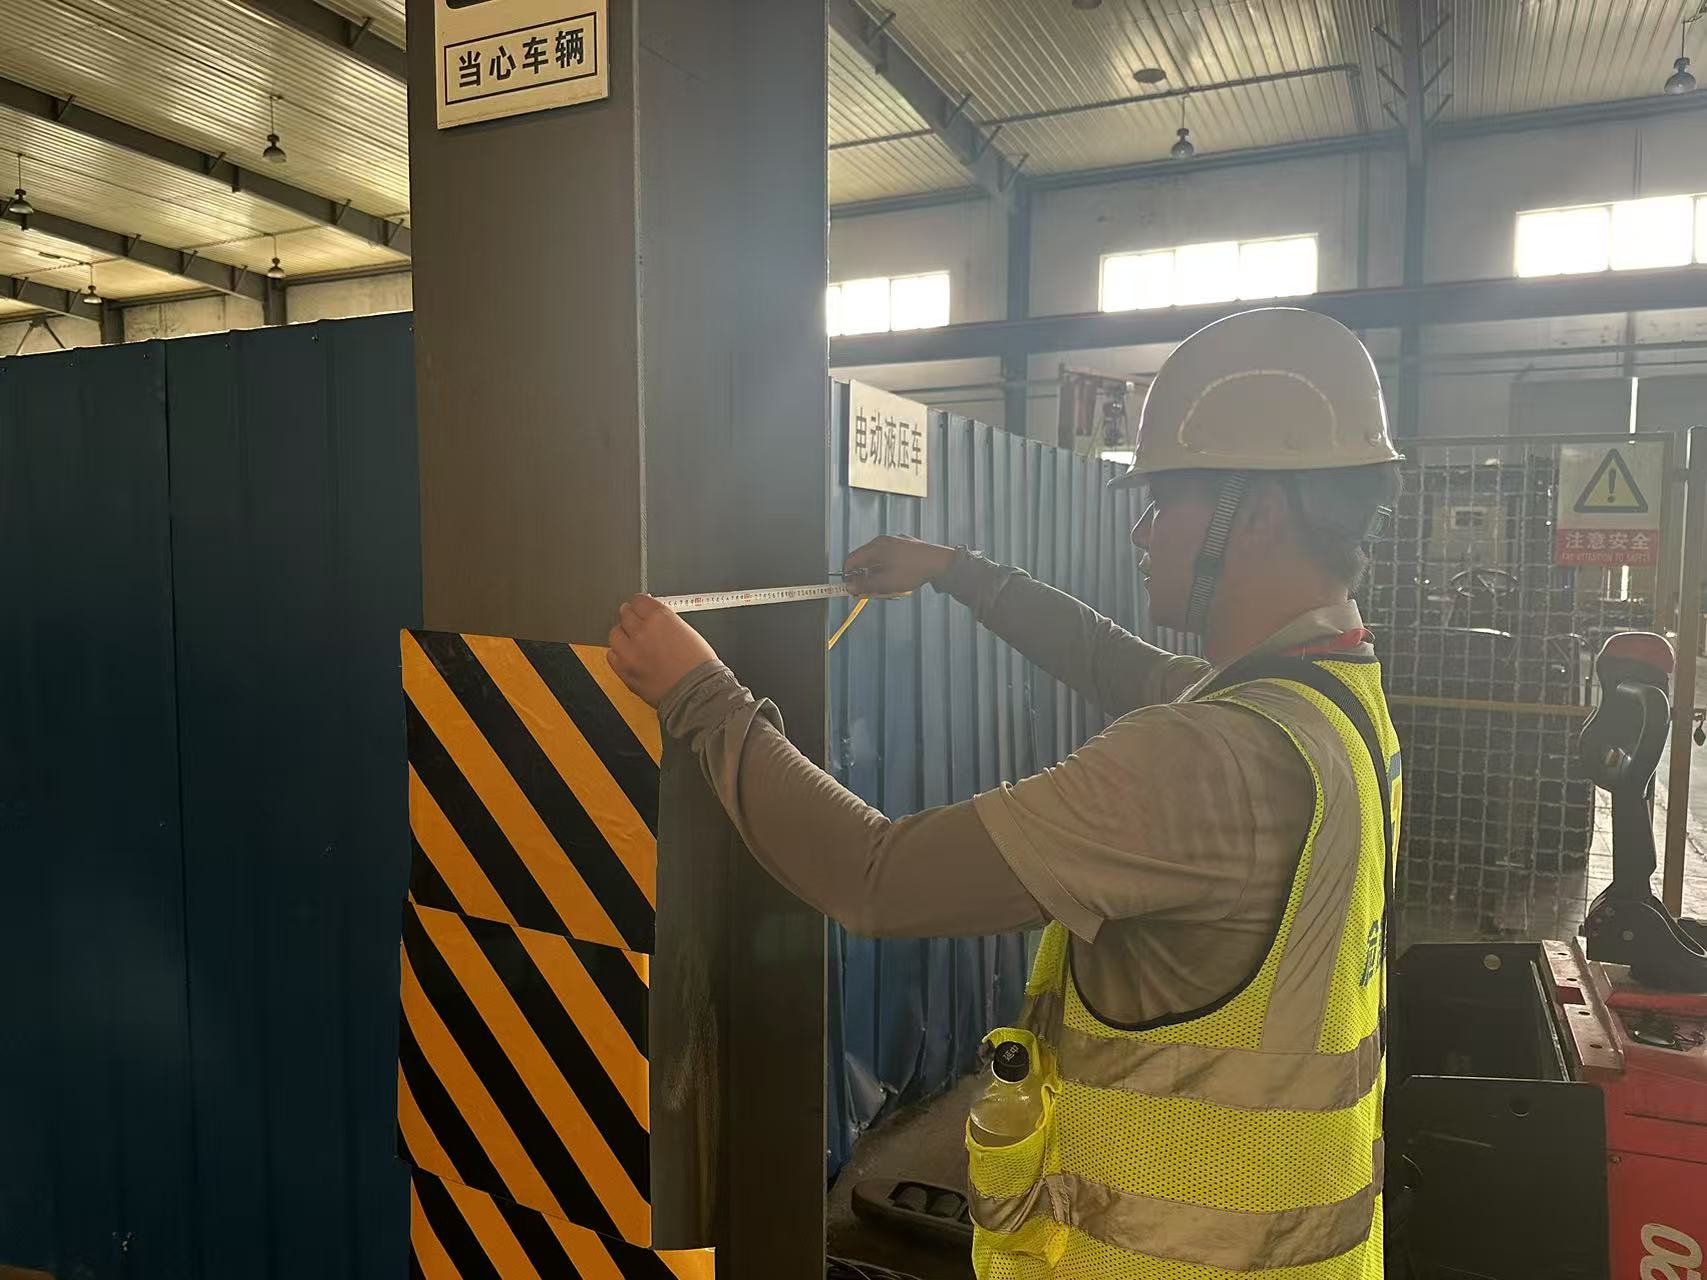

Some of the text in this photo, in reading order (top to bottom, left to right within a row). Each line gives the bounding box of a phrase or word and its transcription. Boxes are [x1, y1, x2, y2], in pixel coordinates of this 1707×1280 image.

[459, 28, 584, 88] 当心车辆
[855, 406, 922, 477] 电动液压车
[1565, 531, 1650, 550] 注意安全
